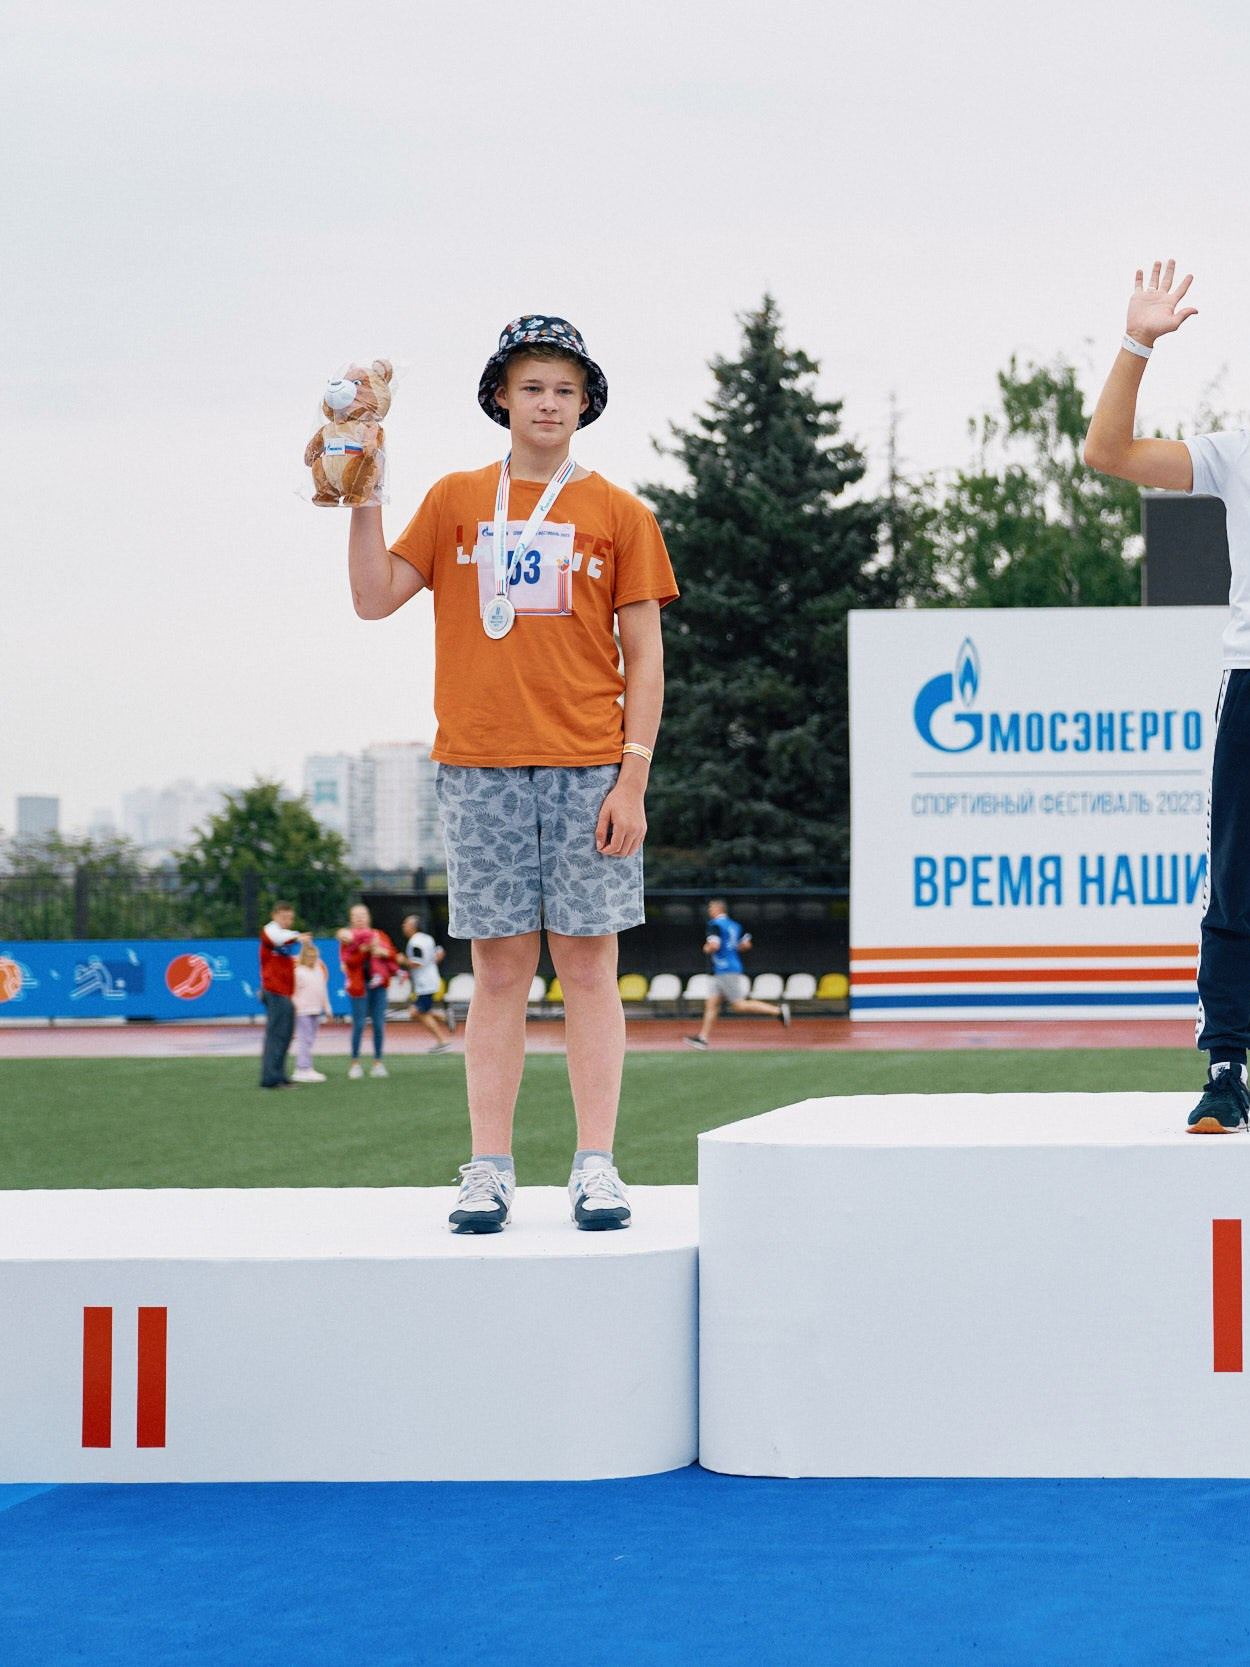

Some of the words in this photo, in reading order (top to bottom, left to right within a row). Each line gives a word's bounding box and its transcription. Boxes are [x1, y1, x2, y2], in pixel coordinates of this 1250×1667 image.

[989, 711, 1202, 752] МОСЭНЕРГО
[911, 788, 1036, 817] СПОРТИВНЫЙ
[1039, 790, 1151, 816] ФЕСТИВАЛЬ
[1156, 789, 1204, 815] 2023
[914, 855, 1061, 907] ВРЕМЯ
[1080, 854, 1207, 905] НАШИ
[82, 1307, 167, 1448] II
